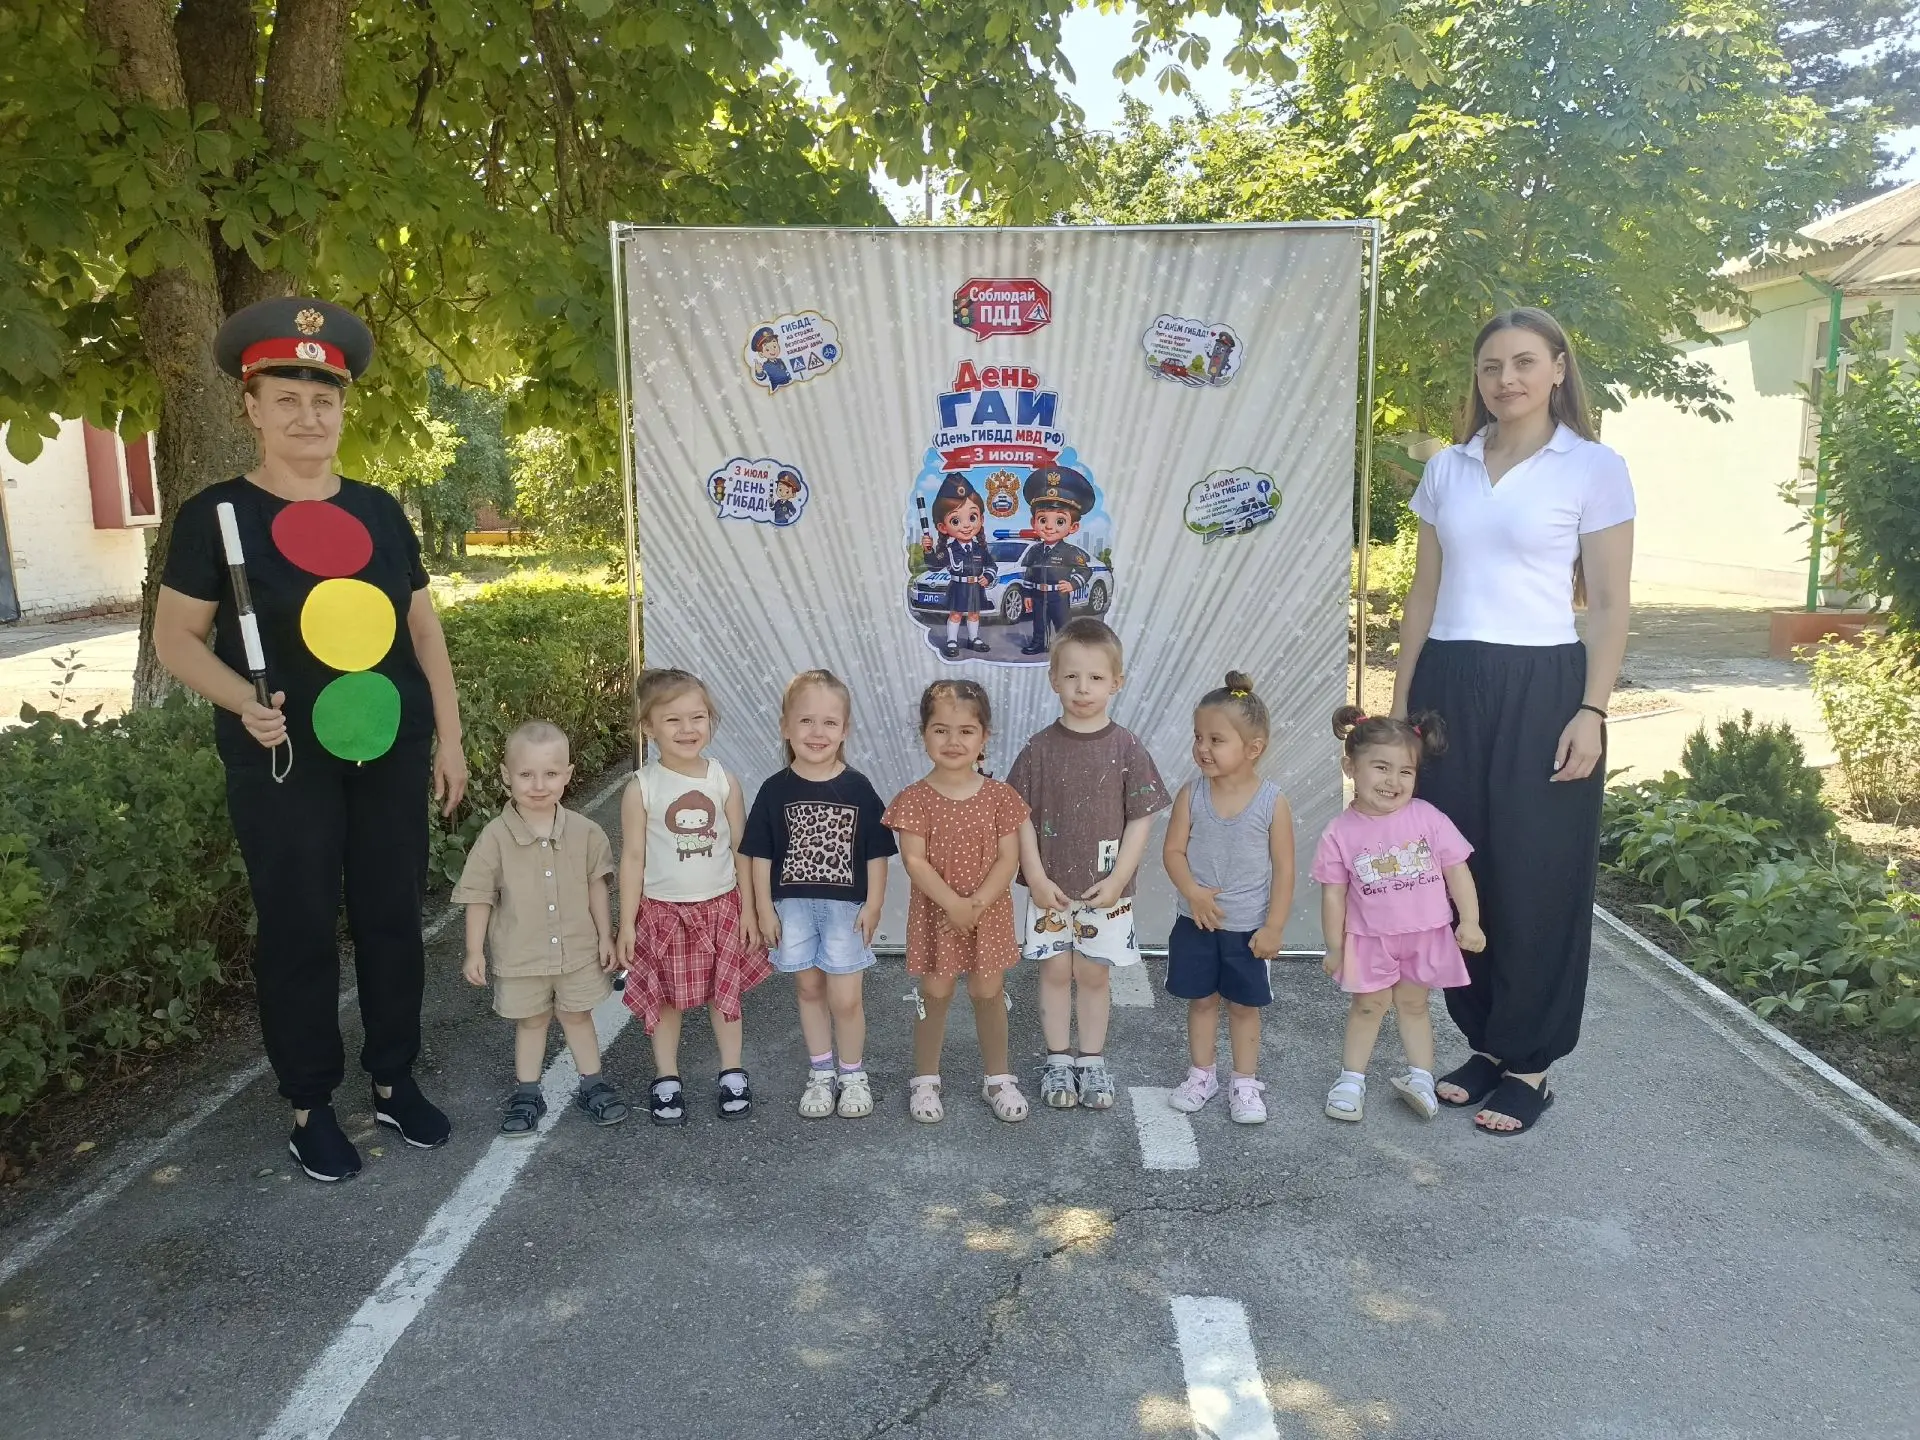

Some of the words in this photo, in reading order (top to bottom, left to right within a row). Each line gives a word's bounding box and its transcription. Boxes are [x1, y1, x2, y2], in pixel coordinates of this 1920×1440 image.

[969, 287, 1036, 303] Соблюдай
[980, 305, 1022, 327] ПДД
[1157, 320, 1164, 329] С
[1184, 326, 1209, 338] ГИБДД!
[953, 360, 1039, 392] День
[939, 390, 1057, 428] ГАИ
[934, 432, 970, 448] (День
[971, 429, 1013, 442] ГИБДД
[1016, 430, 1042, 444] МВД
[1044, 432, 1065, 446] РФ)
[973, 448, 984, 461] 3
[989, 450, 1034, 461] июля
[734, 466, 741, 475] 3
[744, 468, 768, 479] ИЮЛЯ
[733, 480, 765, 494] ДЕНЬ
[1200, 492, 1220, 503] ДЕНЬ
[1222, 482, 1250, 495] ГИБДД!
[1204, 484, 1210, 492] 3
[1212, 478, 1235, 489] ИЮЛЯ
[727, 493, 767, 512] ГИБДД!
[925, 572, 951, 581] ДПС
[923, 594, 939, 602] ДПС
[1106, 901, 1131, 920] AFARI
